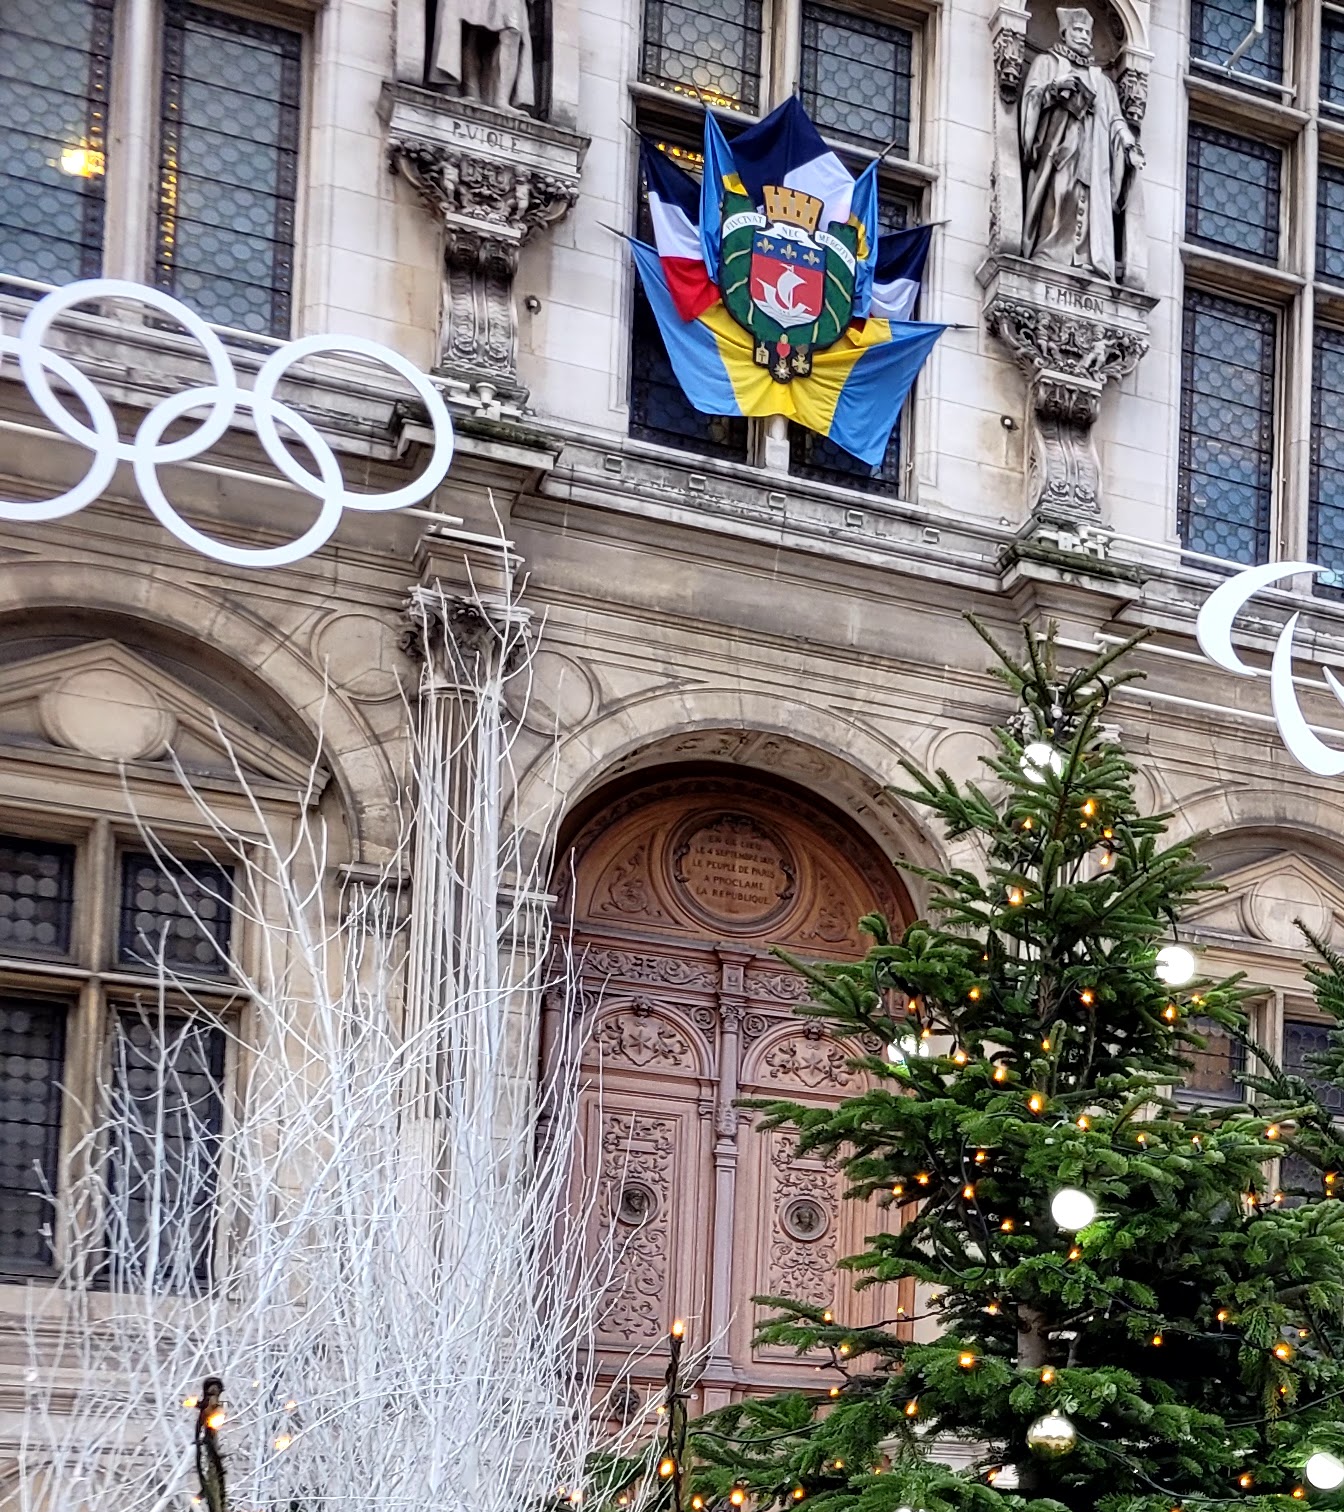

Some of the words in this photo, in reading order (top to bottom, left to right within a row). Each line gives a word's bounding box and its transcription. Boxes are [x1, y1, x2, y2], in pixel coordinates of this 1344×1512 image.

[692, 859, 702, 868] LE
[738, 866, 749, 874] DE
[751, 867, 775, 879] PARIS
[696, 886, 708, 896] LA
